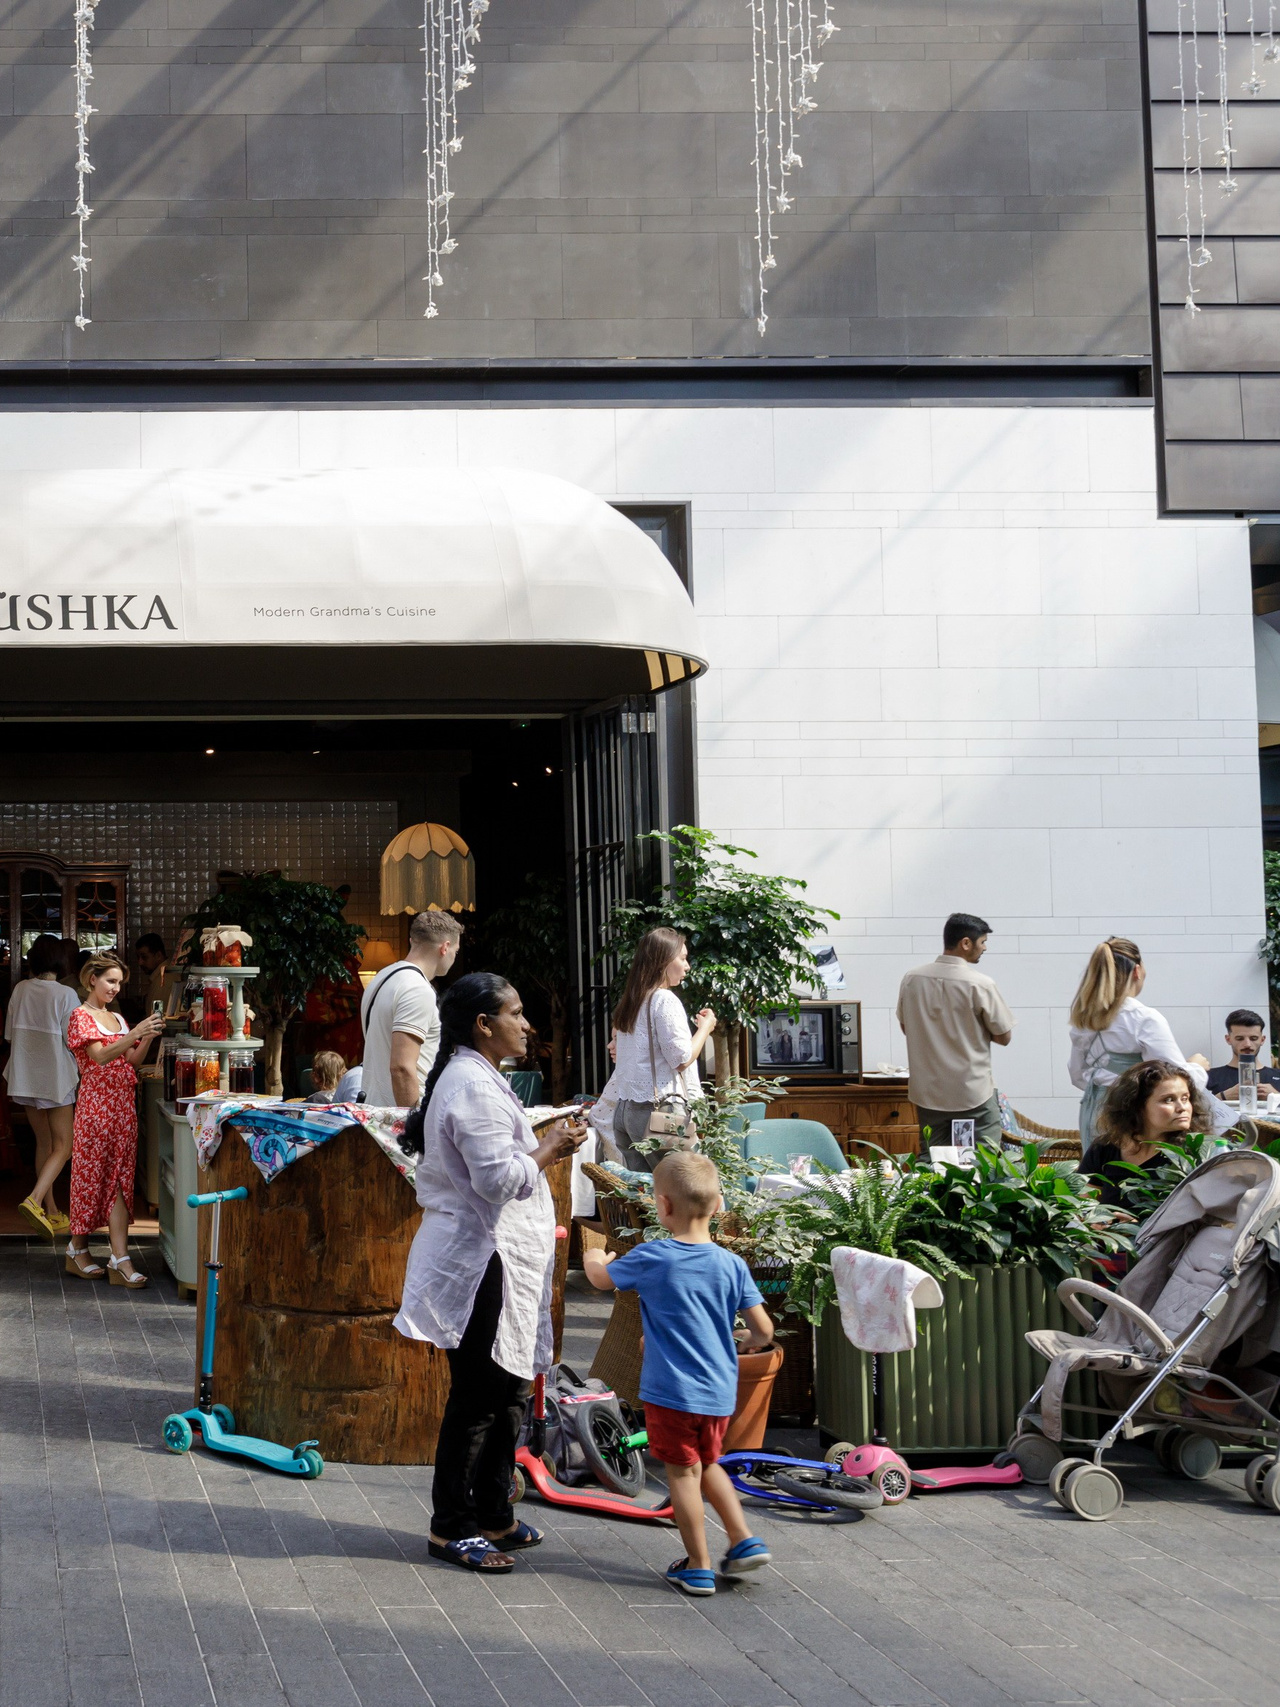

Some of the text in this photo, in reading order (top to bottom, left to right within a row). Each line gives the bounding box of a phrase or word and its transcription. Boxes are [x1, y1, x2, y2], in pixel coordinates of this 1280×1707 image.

[253, 606, 437, 617] Modern Grandma's Cuisine
